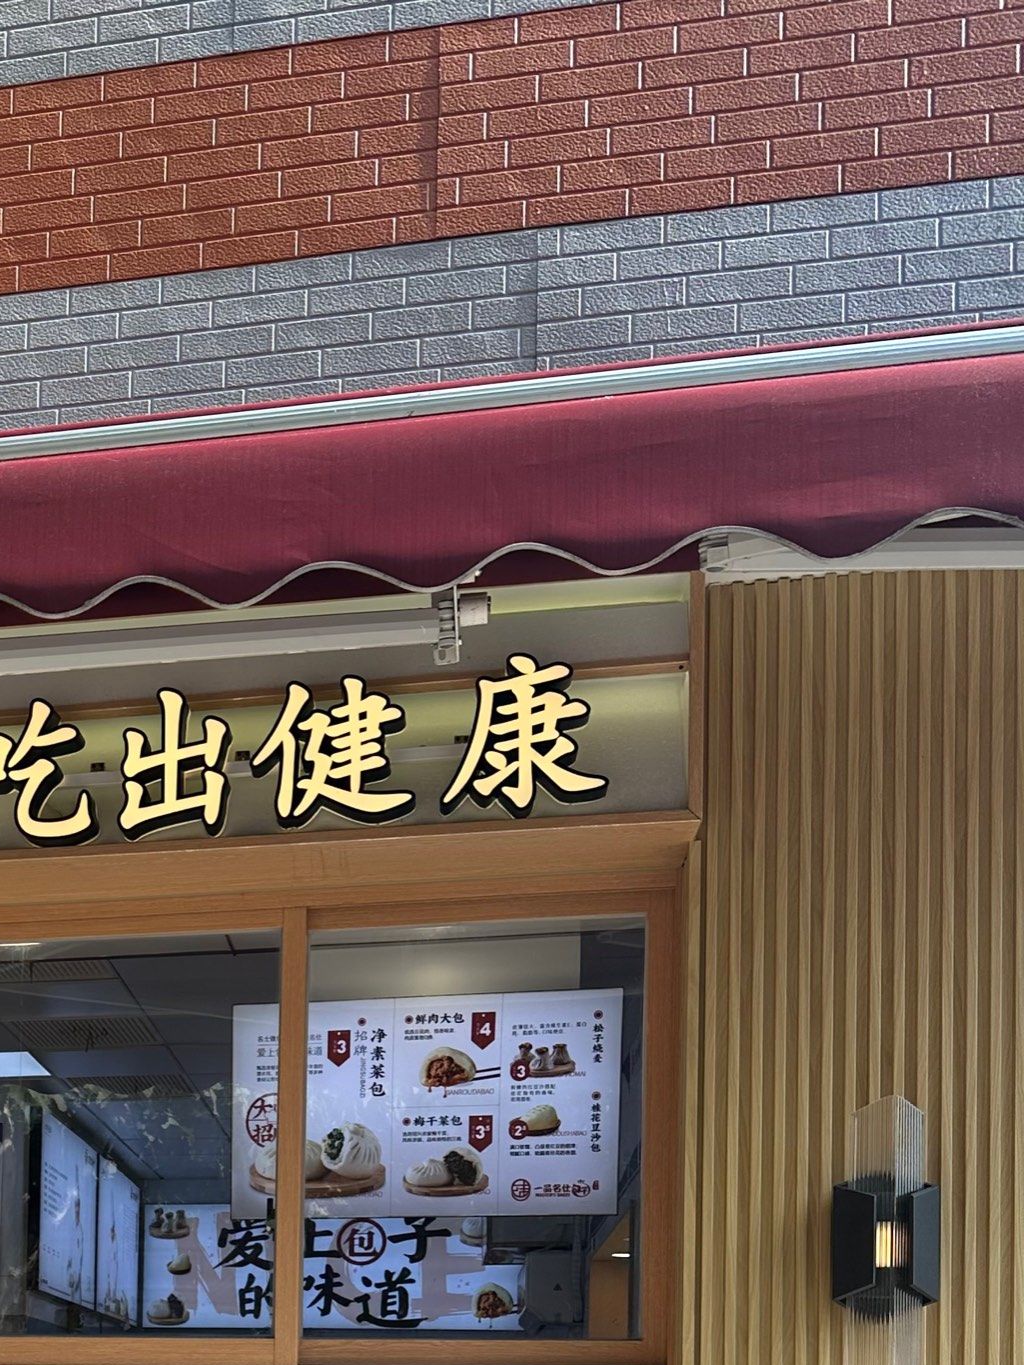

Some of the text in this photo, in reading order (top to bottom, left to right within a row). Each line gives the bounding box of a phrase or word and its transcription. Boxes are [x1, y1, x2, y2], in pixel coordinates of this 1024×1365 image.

[415, 1013, 465, 1024] 鲜肉大包
[479, 1022, 492, 1037] 4
[337, 1040, 347, 1054] 3
[369, 1028, 388, 1097] 净素菜包
[516, 1065, 526, 1078] 3
[414, 1116, 463, 1127] 梅干菜包
[591, 1103, 601, 1152] 桂花豆沙包
